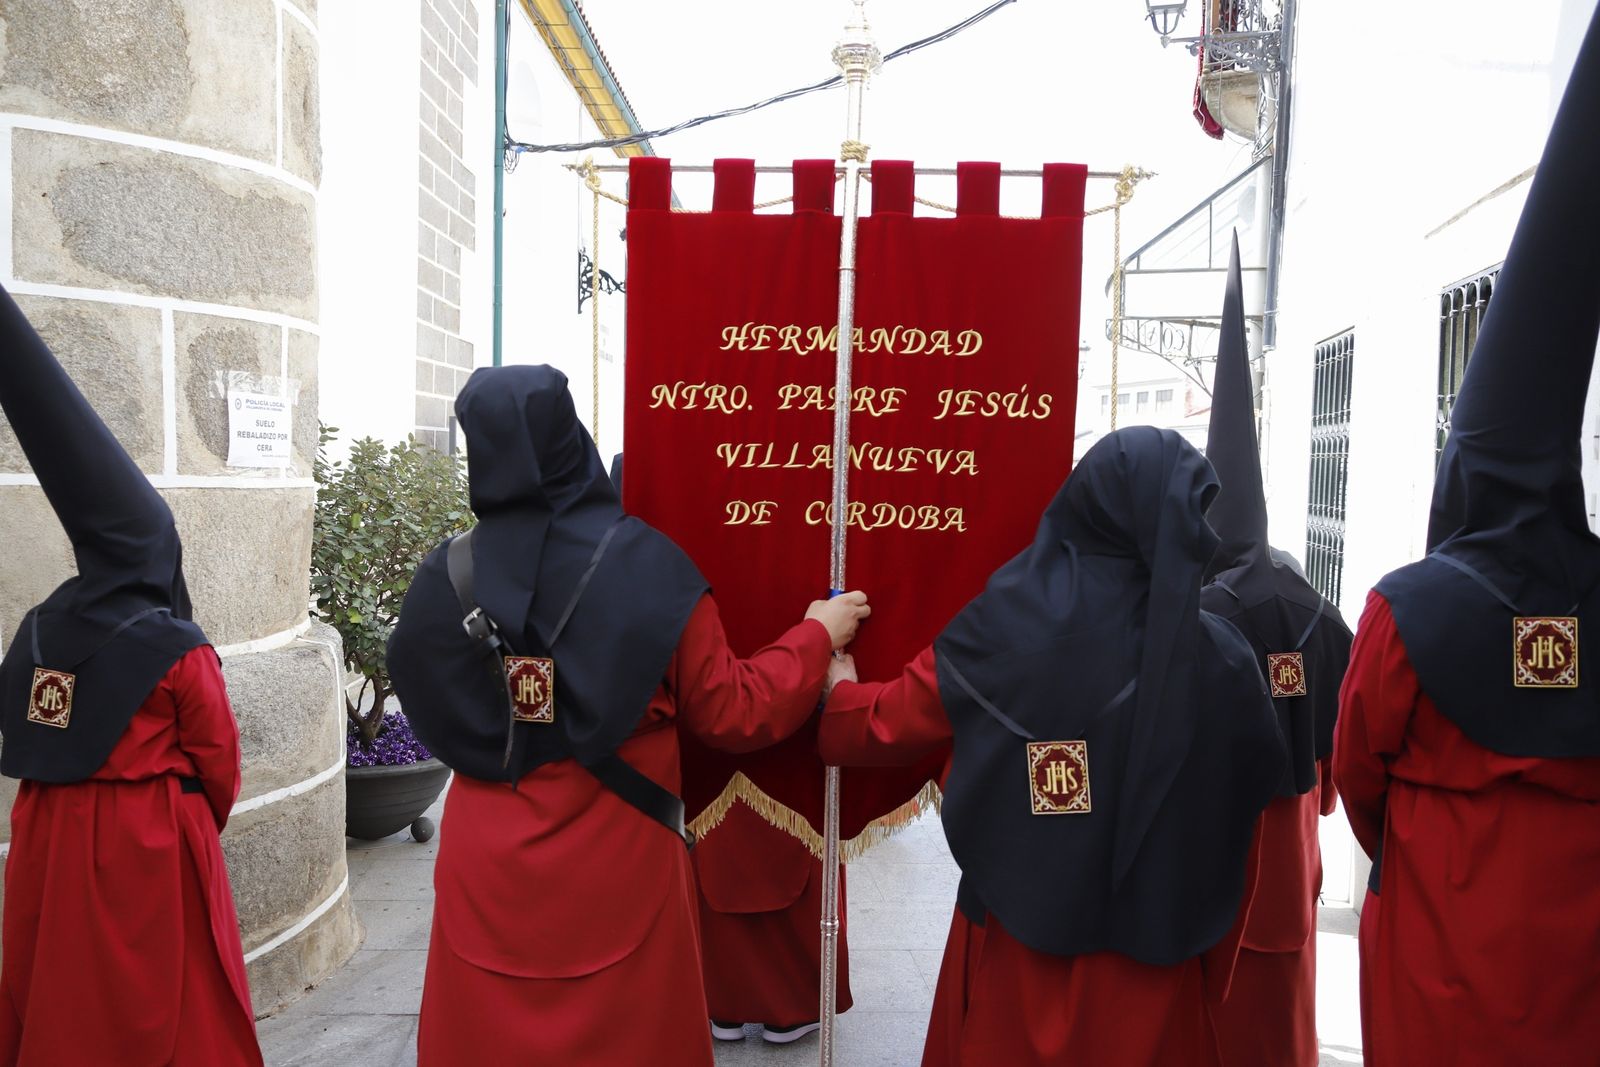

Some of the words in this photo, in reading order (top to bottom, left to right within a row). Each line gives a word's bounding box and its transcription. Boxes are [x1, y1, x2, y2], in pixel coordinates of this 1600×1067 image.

[649, 380, 753, 415] NTRO.
[932, 383, 1053, 420] JESÚS
[237, 430, 276, 439] REBALADIZO
[277, 433, 288, 441] POR
[255, 419, 275, 428] SUELO
[256, 444, 273, 452] CERA
[716, 441, 980, 476] VILLANUEVA
[723, 500, 778, 526] DE
[1526, 635, 1565, 669] JHS
[514, 674, 543, 705] JHS
[1042, 760, 1078, 795] JHS
